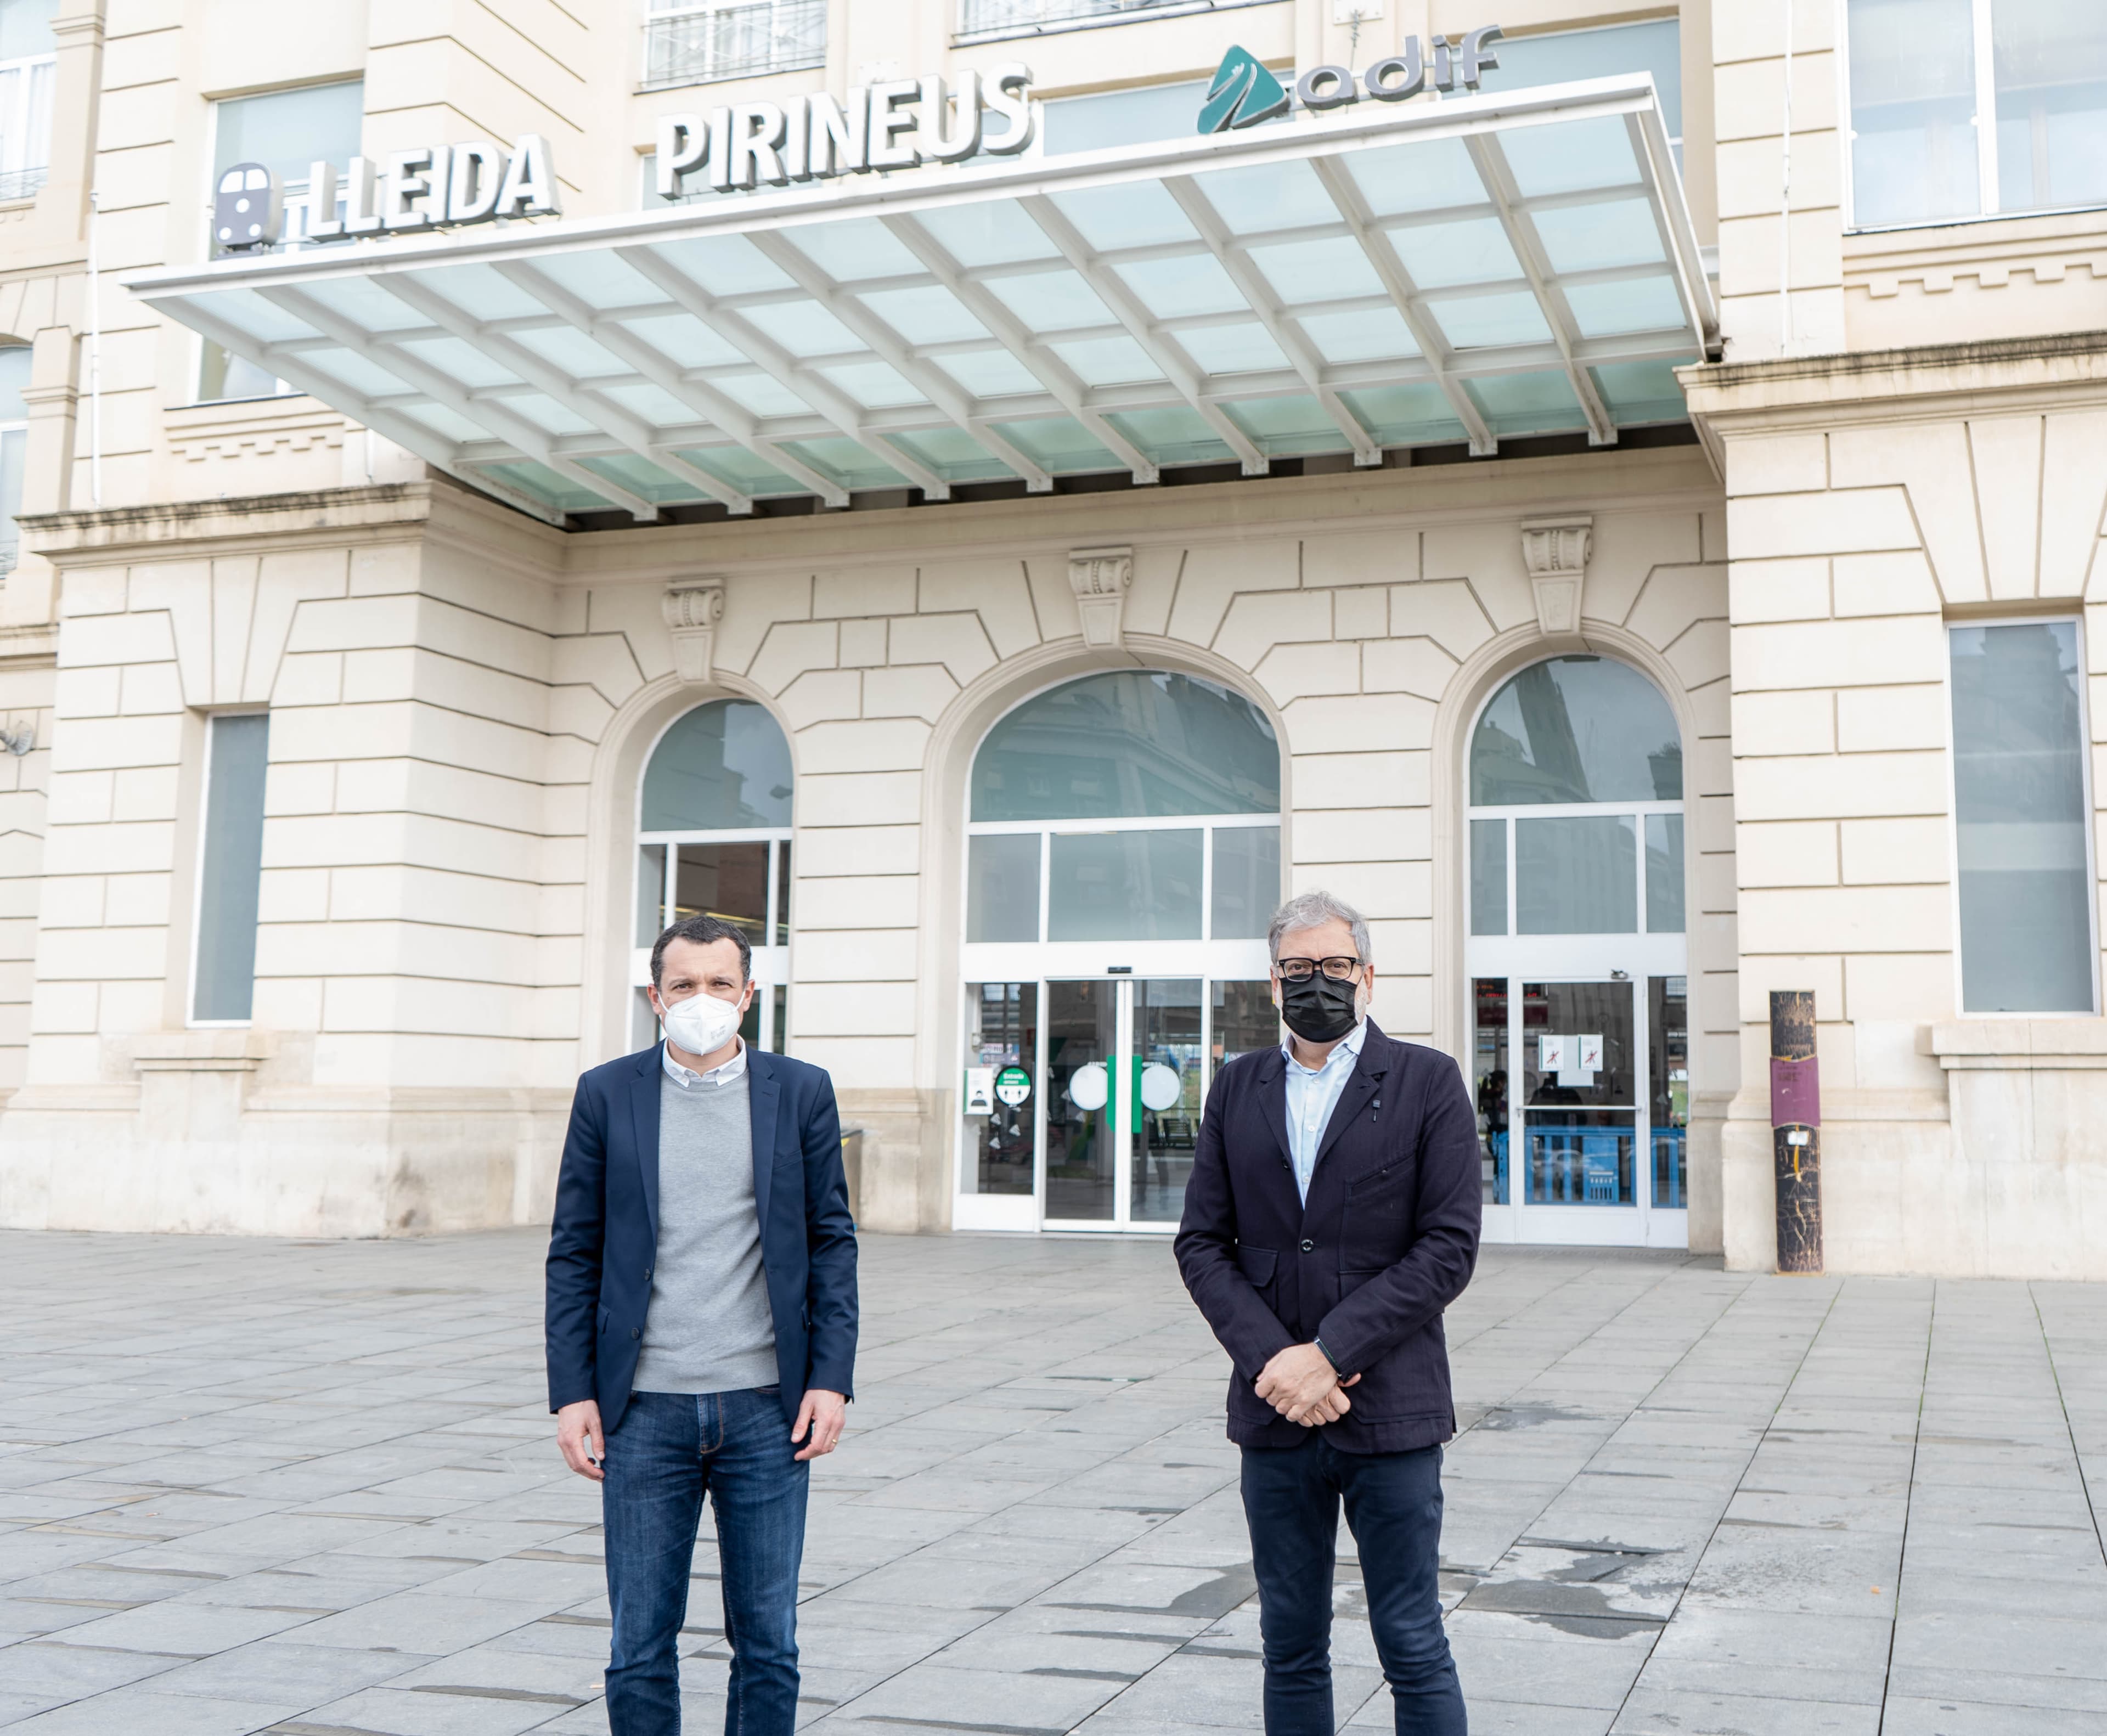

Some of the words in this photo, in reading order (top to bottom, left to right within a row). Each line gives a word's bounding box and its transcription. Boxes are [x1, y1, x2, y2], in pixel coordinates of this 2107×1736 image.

[1297, 25, 1505, 109] adif
[306, 133, 559, 241] LLEIDA
[656, 61, 1034, 199] PIRINEUS
